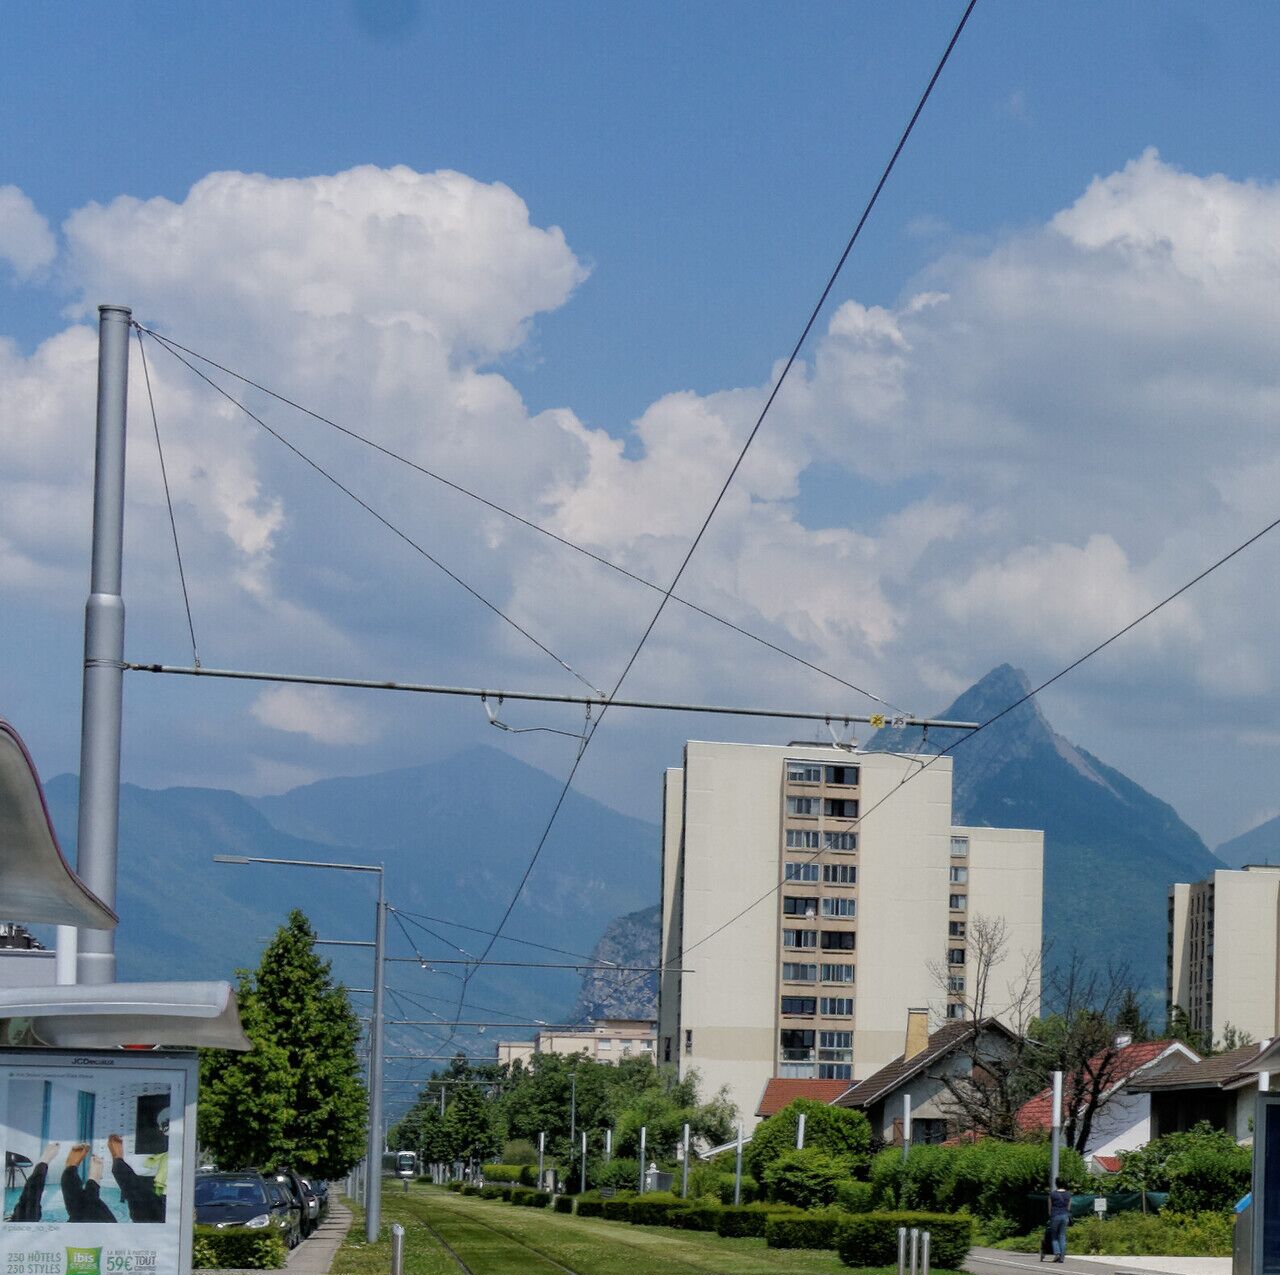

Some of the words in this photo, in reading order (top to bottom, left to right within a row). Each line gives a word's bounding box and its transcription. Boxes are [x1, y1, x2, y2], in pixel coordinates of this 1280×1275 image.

[28, 1250, 61, 1263] HÔTELS
[73, 1251, 95, 1263] ibis
[27, 1263, 61, 1274] STYLES
[106, 1256, 133, 1271] 59€
[135, 1255, 157, 1266] TOUT
